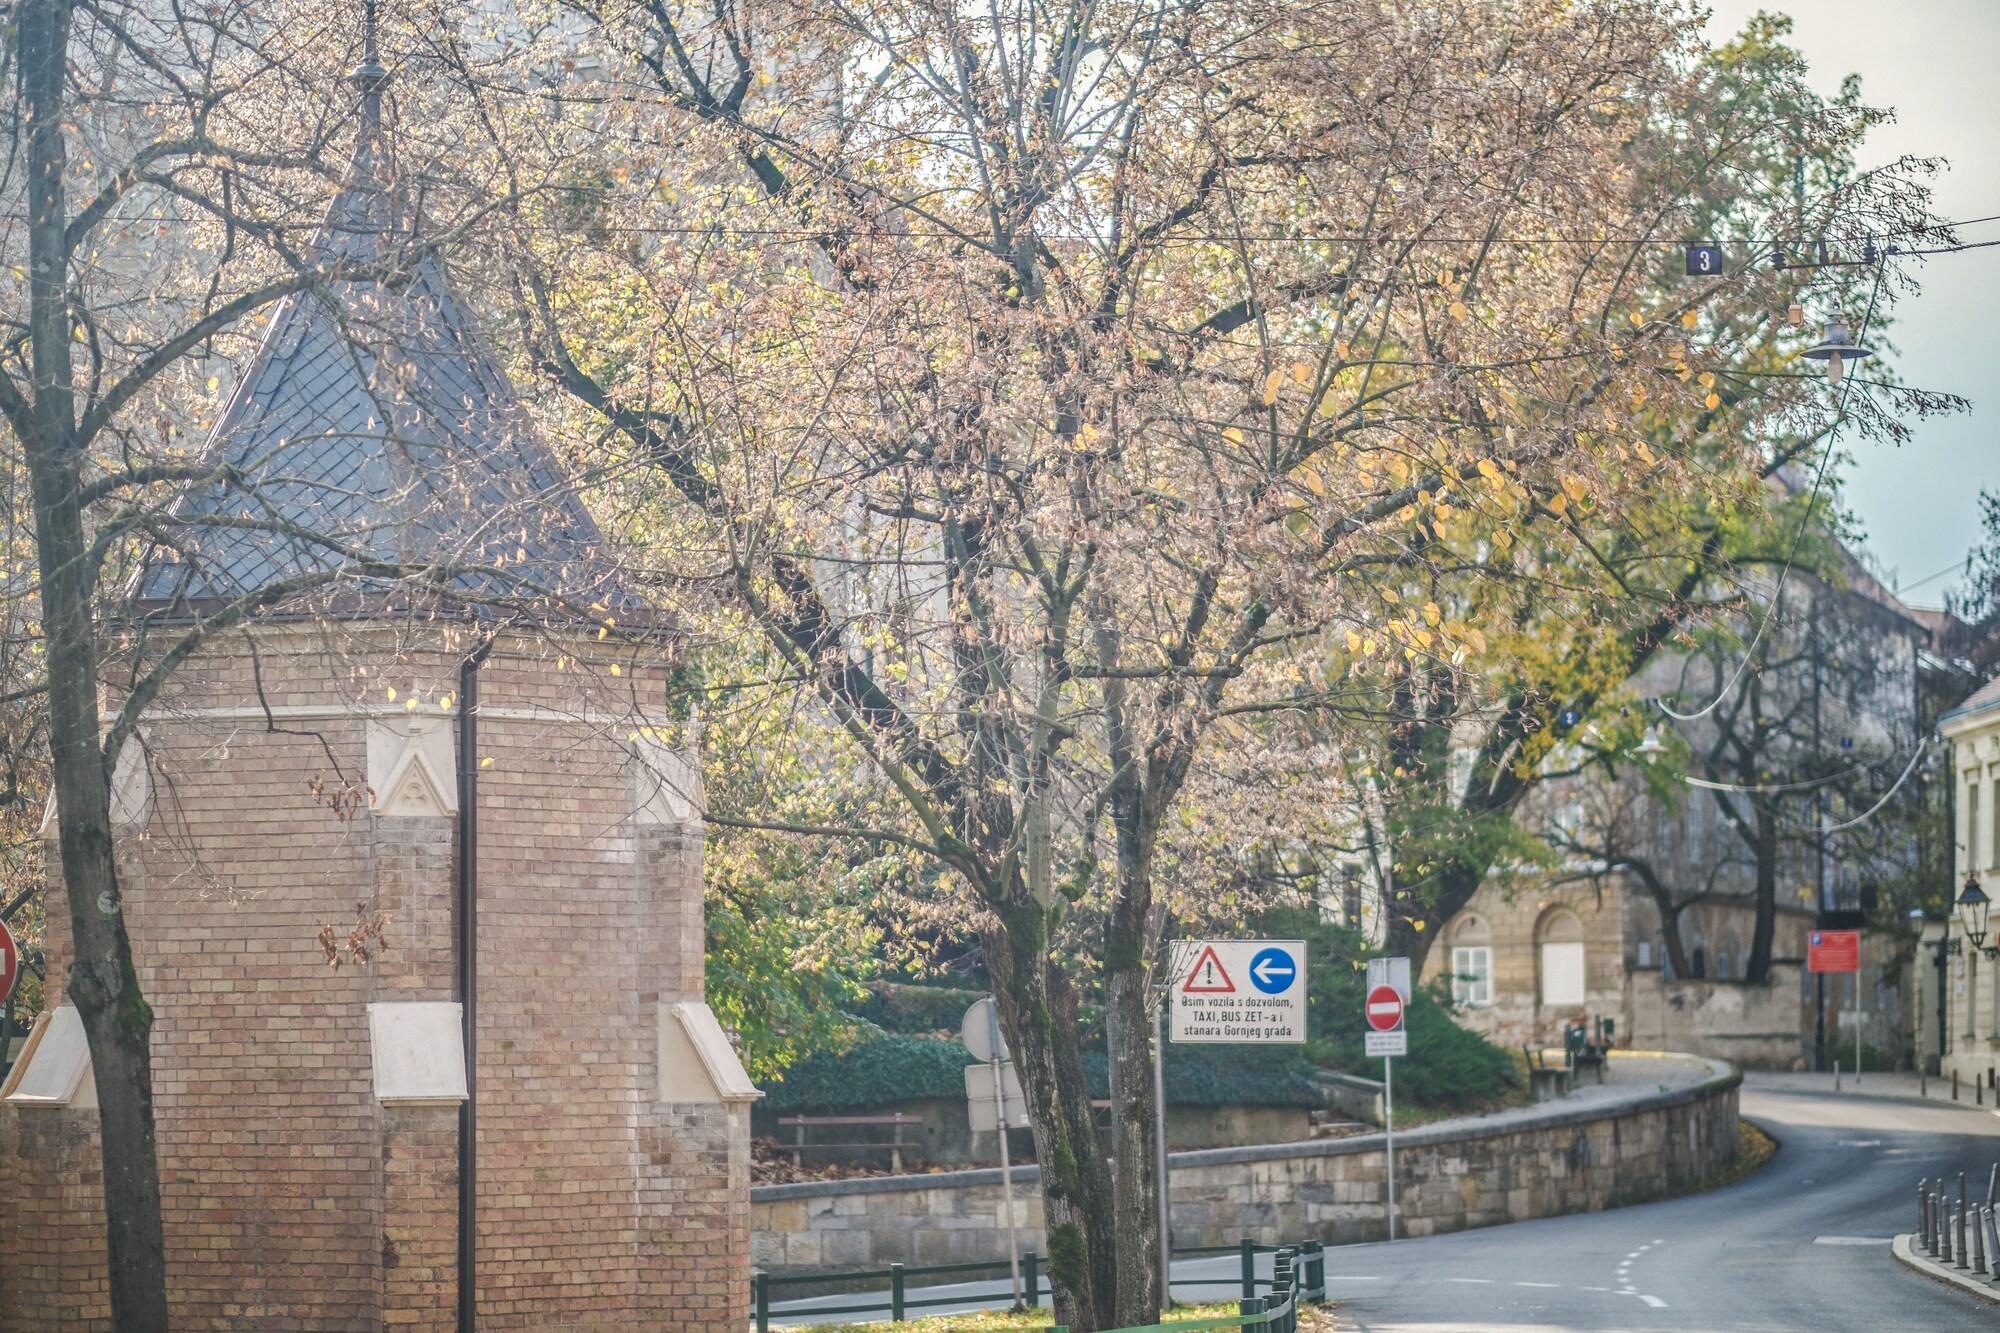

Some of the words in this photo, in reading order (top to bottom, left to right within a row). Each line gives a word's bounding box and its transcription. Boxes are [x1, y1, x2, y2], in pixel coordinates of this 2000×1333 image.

[1700, 251, 1710, 271] 3
[1182, 996, 1204, 1007] Osim
[1208, 996, 1234, 1007] vozila
[1238, 998, 1243, 1007] s
[1246, 996, 1293, 1009] dozvolom,
[1245, 1011, 1276, 1022] ZET-a
[1184, 1026, 1221, 1036] stanara
[1225, 1025, 1261, 1038] Gornjeg
[1265, 1026, 1292, 1038] grada
